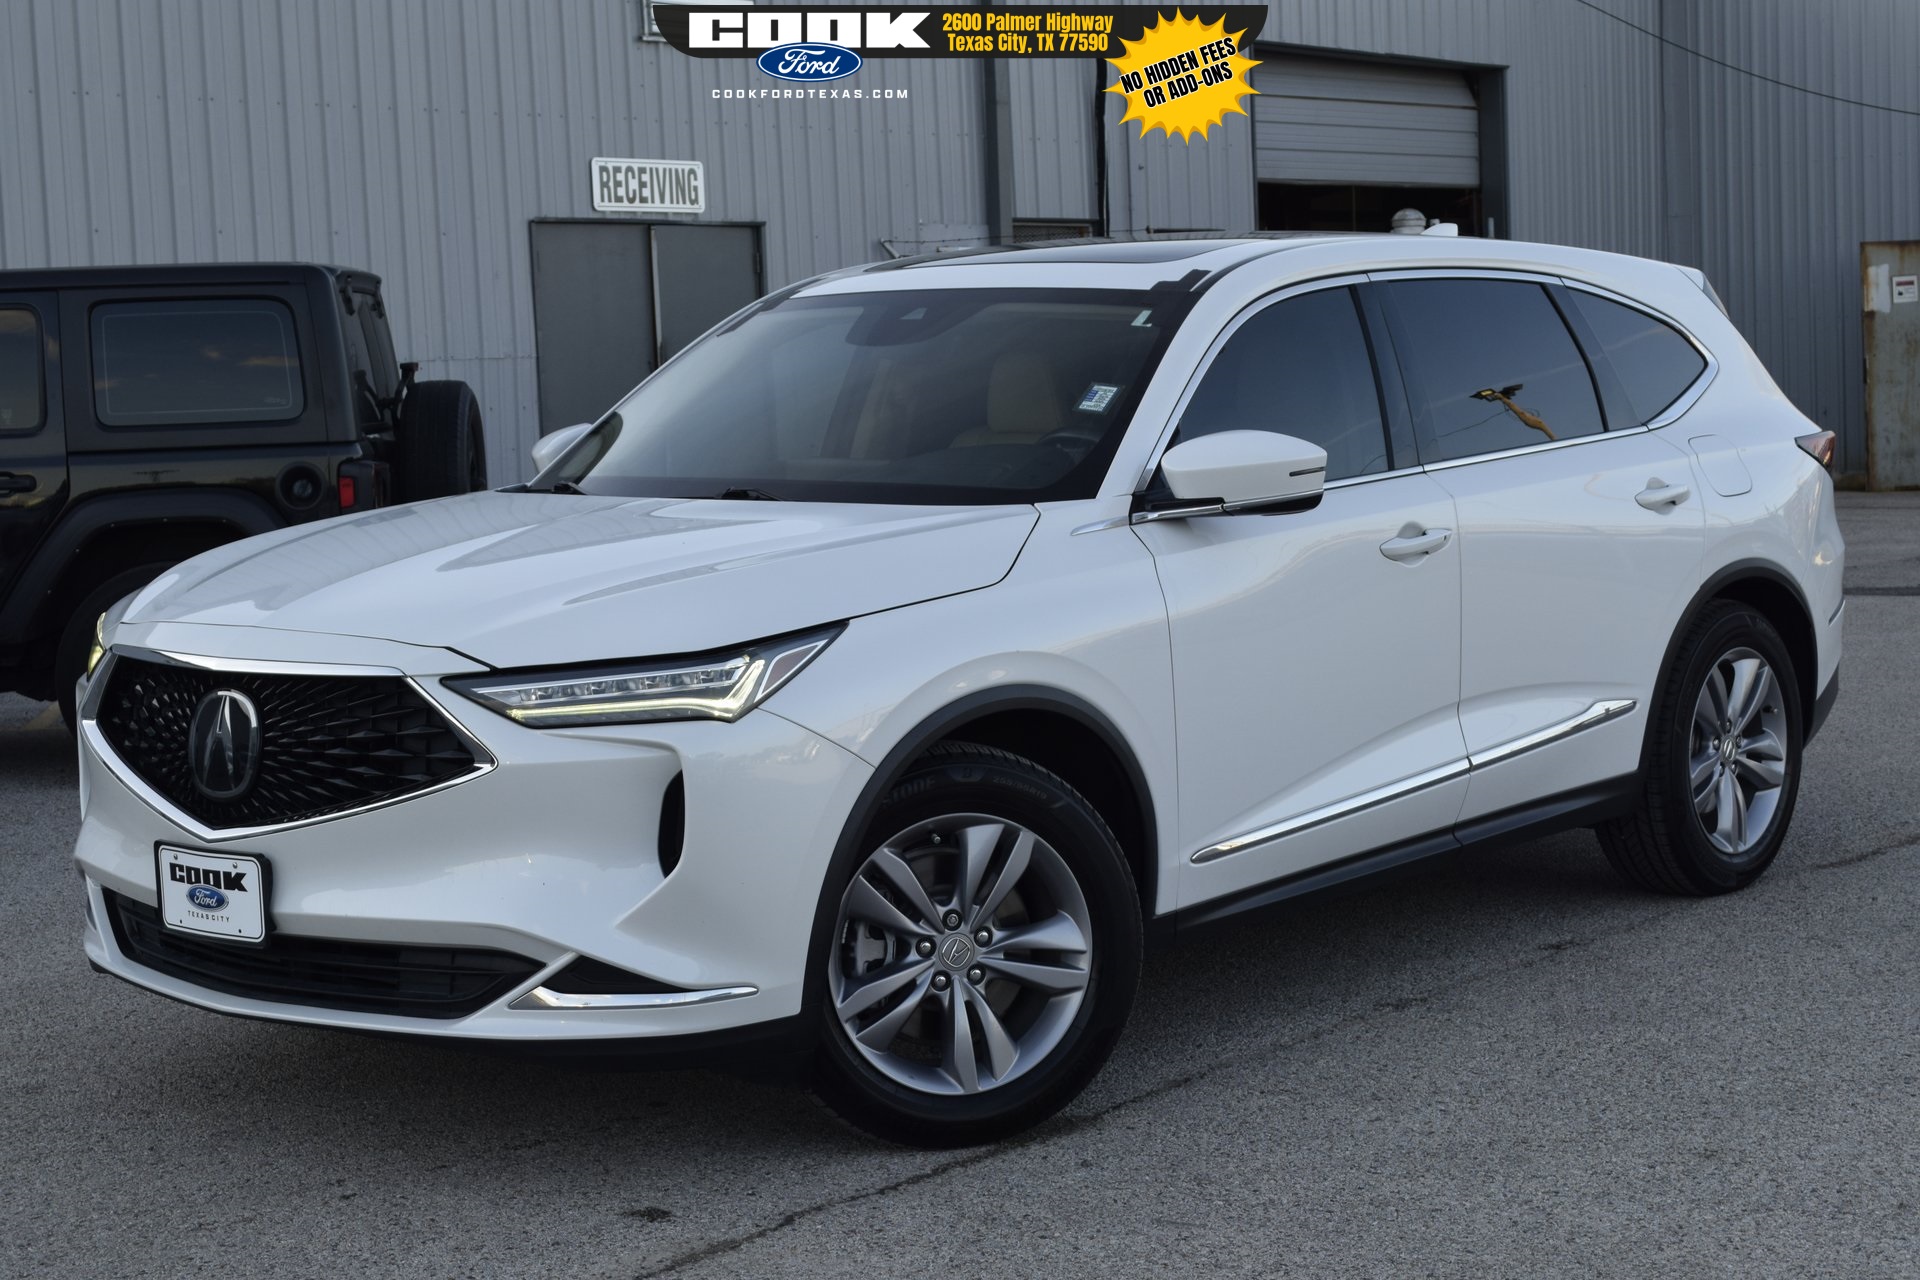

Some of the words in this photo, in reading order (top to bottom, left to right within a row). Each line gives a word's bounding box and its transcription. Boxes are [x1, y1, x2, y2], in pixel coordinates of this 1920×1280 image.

[599, 165, 699, 206] RECEIVING
[169, 862, 248, 892] COOK
[194, 888, 218, 907] Ford
[188, 910, 210, 920] TEXAS
[211, 914, 230, 922] CITY
